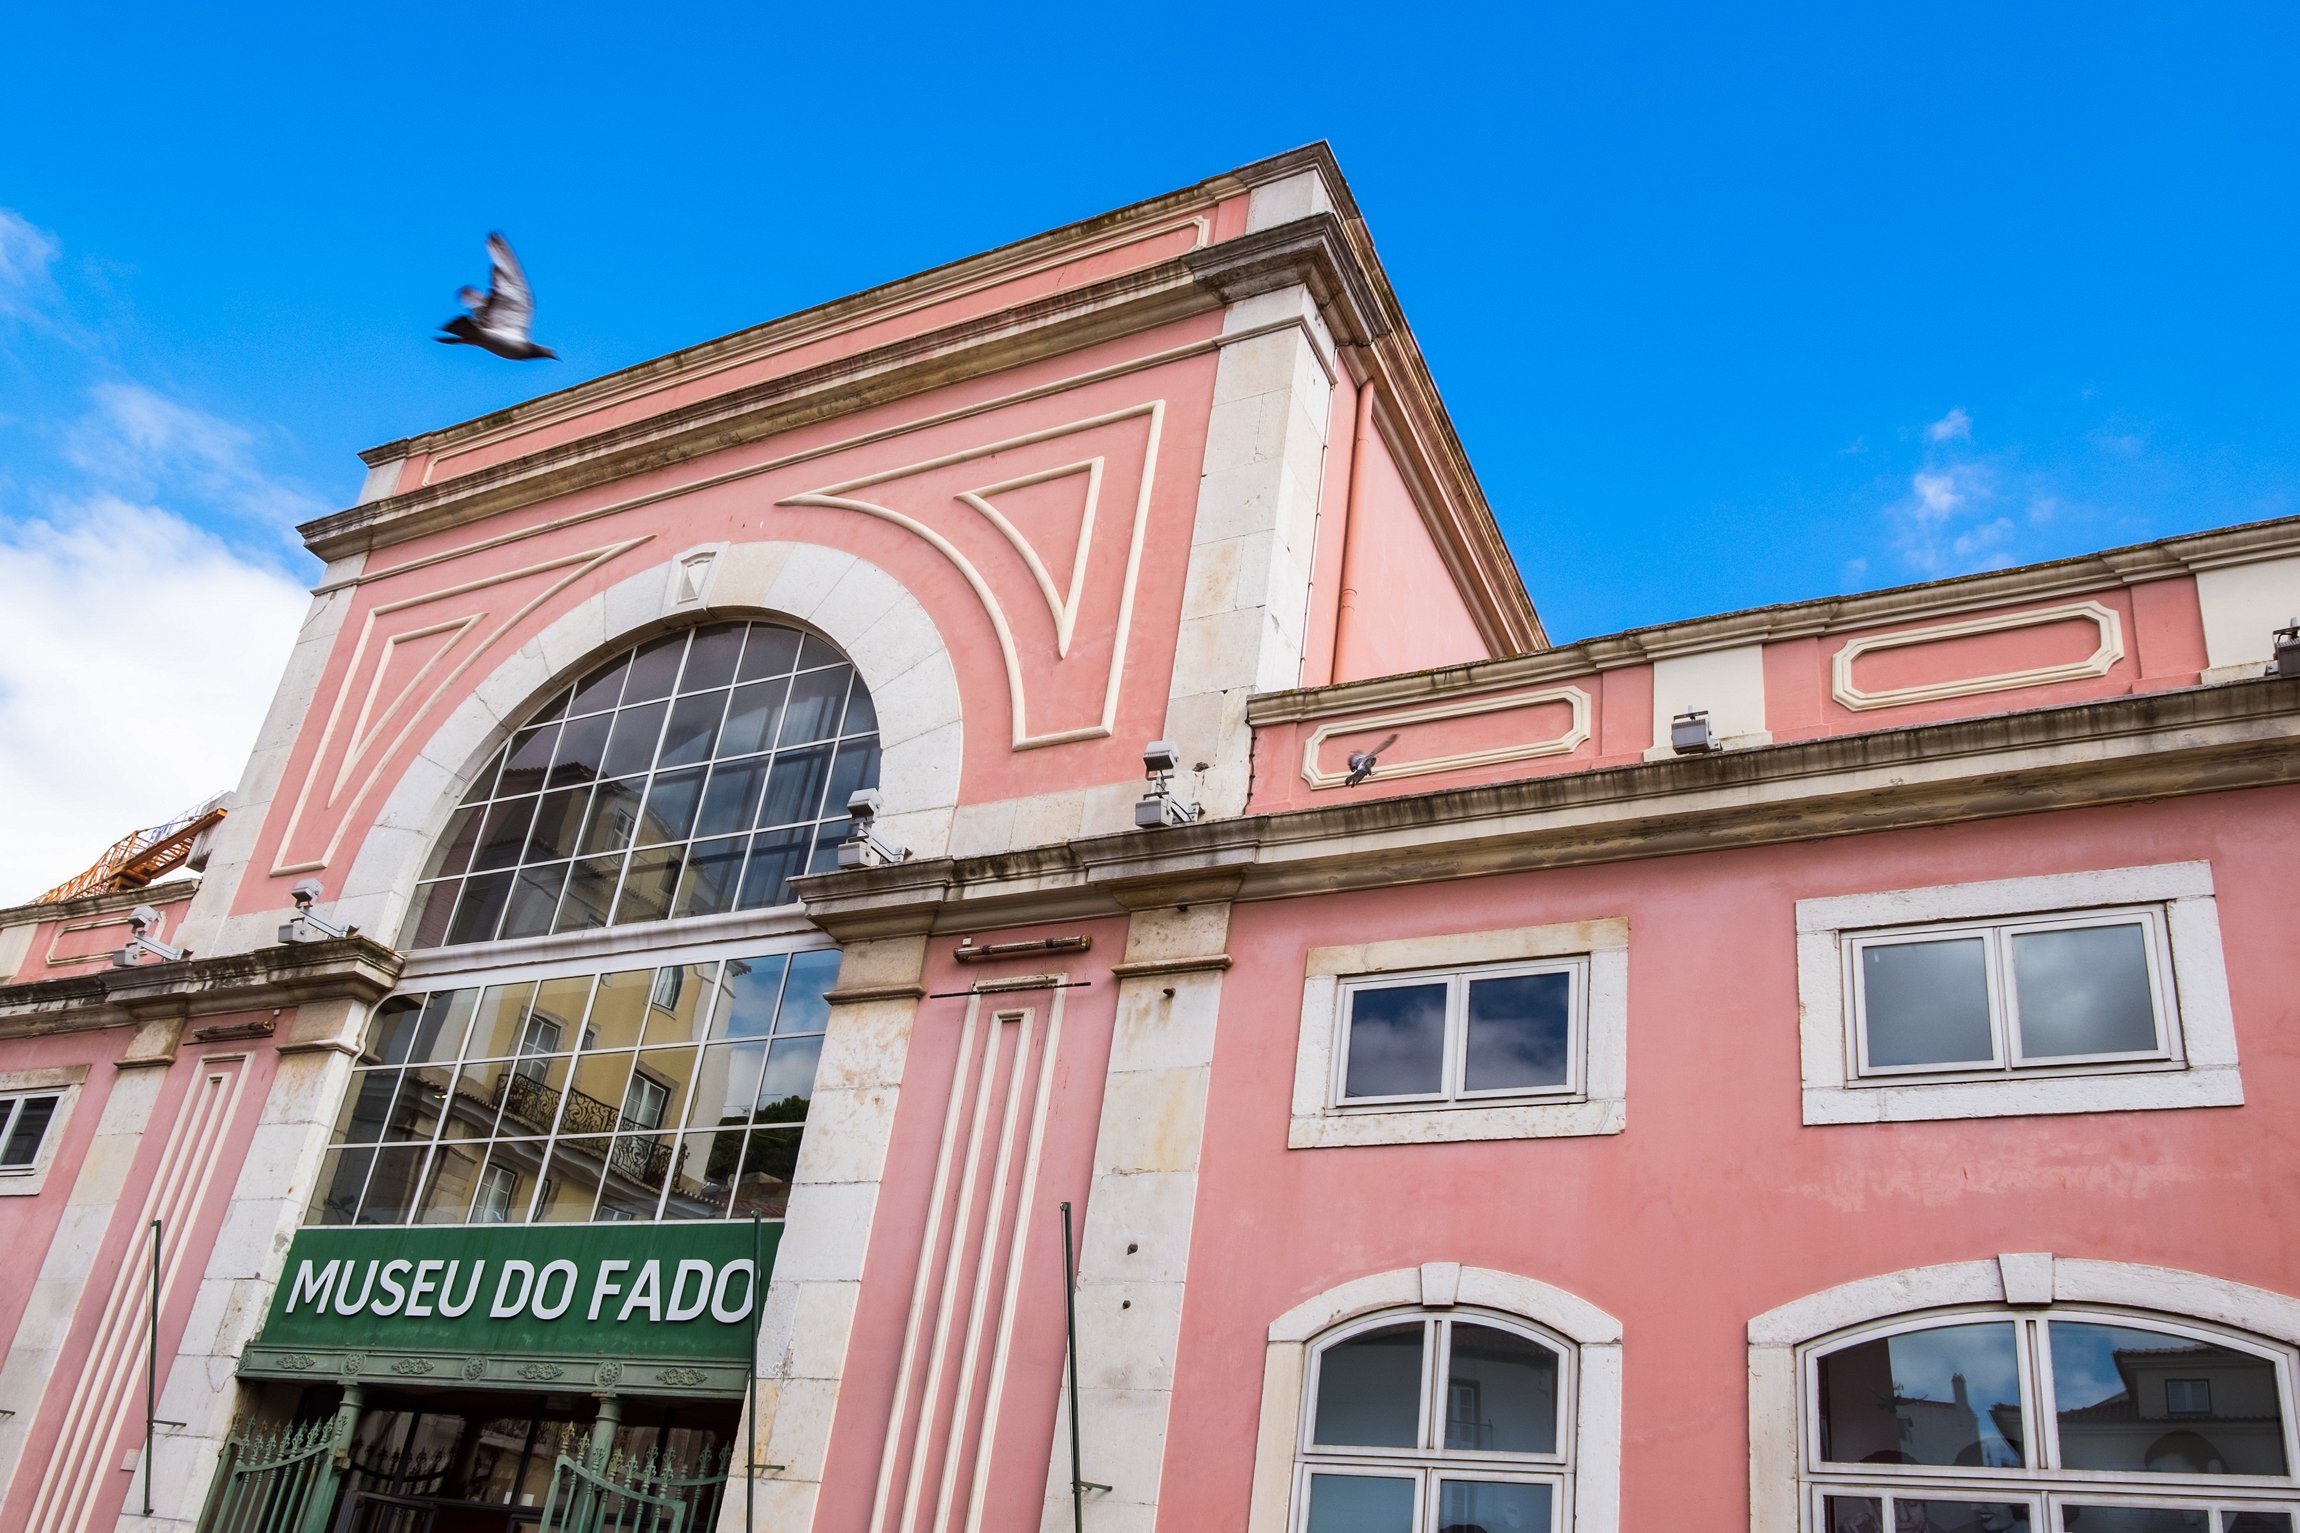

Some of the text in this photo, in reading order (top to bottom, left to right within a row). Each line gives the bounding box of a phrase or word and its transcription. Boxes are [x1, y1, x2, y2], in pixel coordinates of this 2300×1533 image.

[285, 1258, 761, 1324] MUSEU DO FADO
